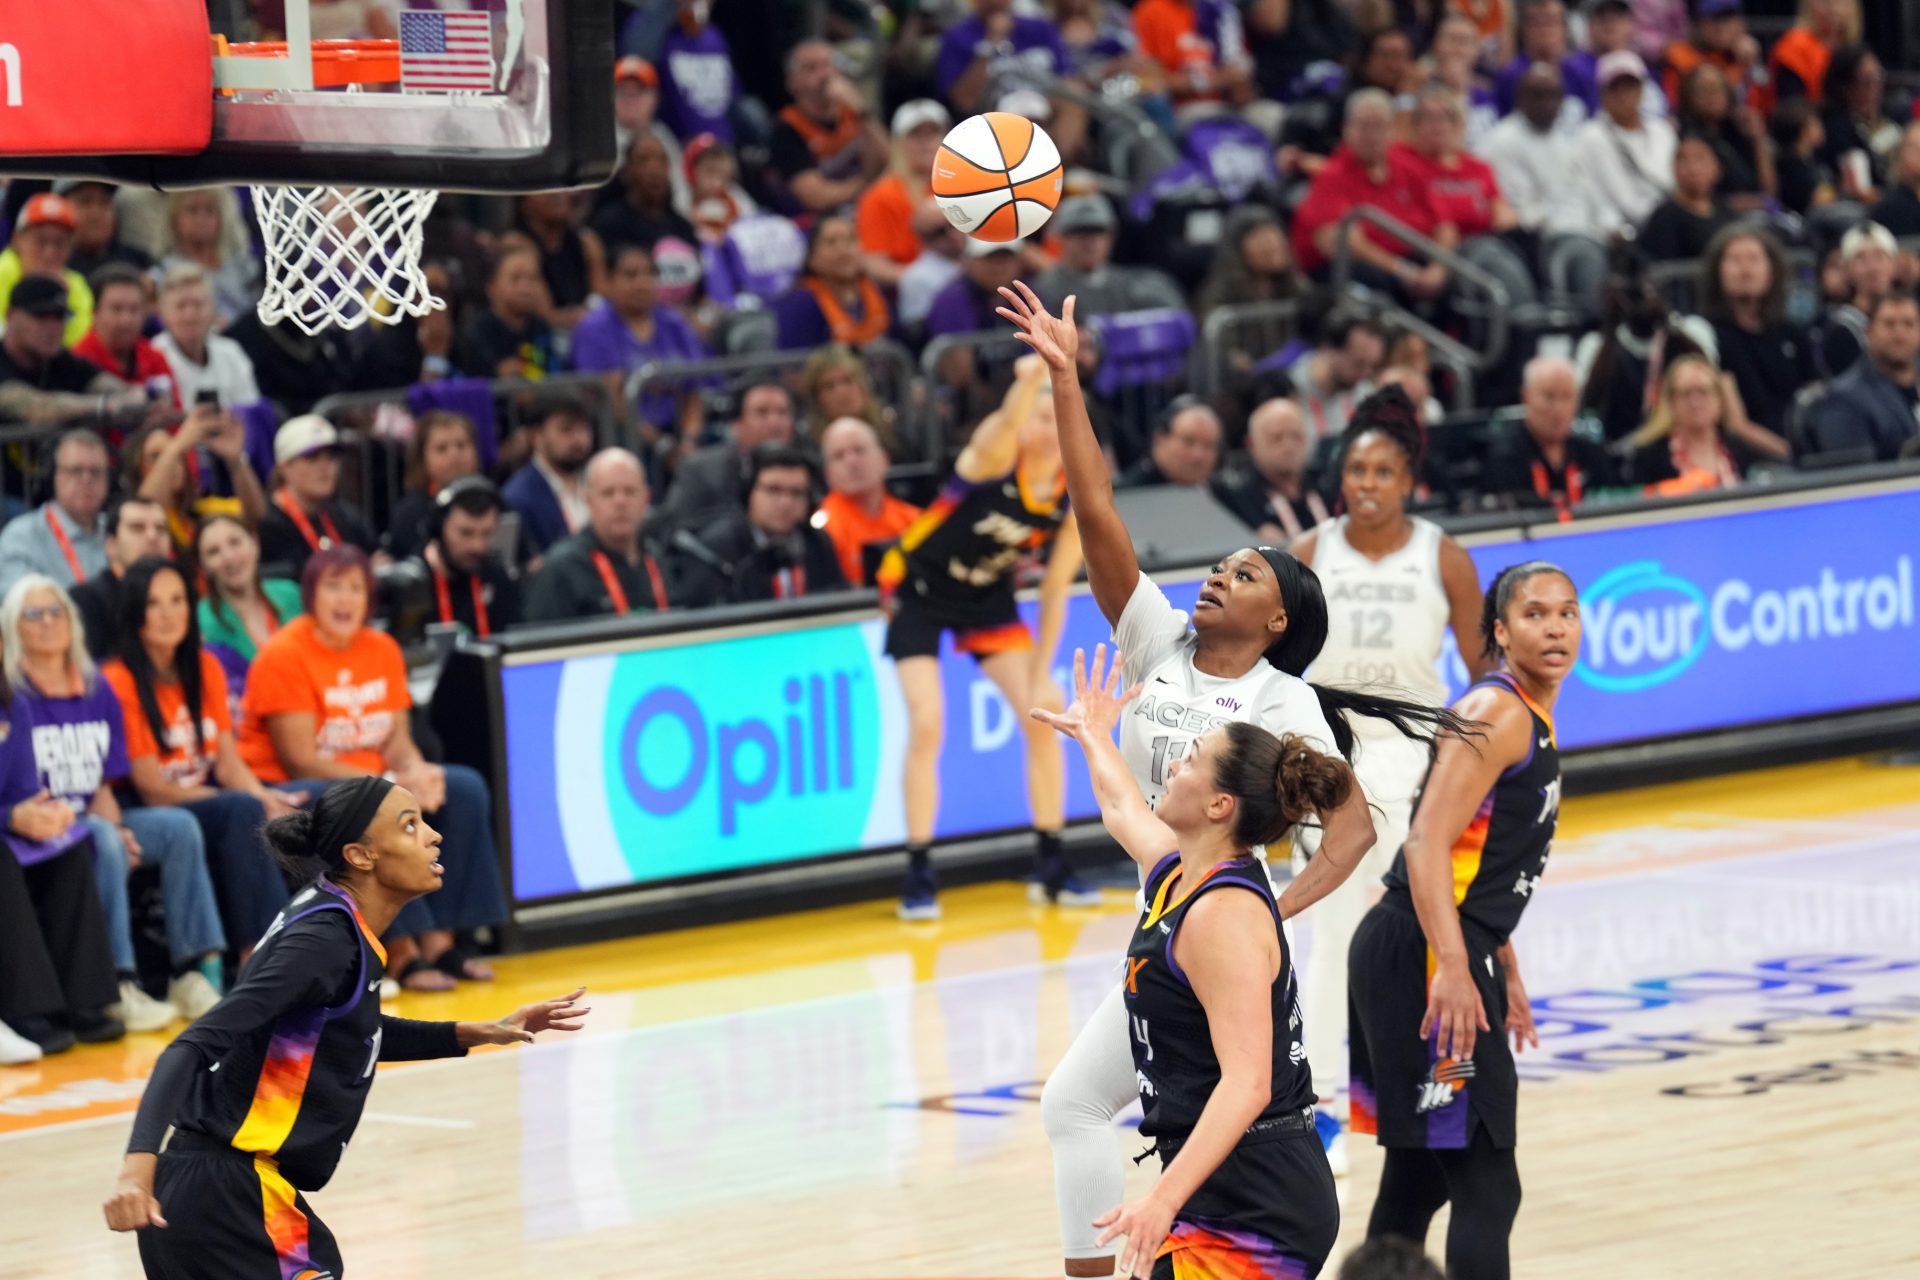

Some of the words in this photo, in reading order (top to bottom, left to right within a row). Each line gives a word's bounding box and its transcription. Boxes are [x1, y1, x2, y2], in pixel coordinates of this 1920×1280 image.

[1330, 582, 1416, 603] ACES
[1579, 598, 1699, 668] Your
[1710, 556, 1912, 651] Control
[1350, 609, 1393, 649] 12
[1215, 697, 1242, 713] ally
[619, 670, 856, 837] Opill
